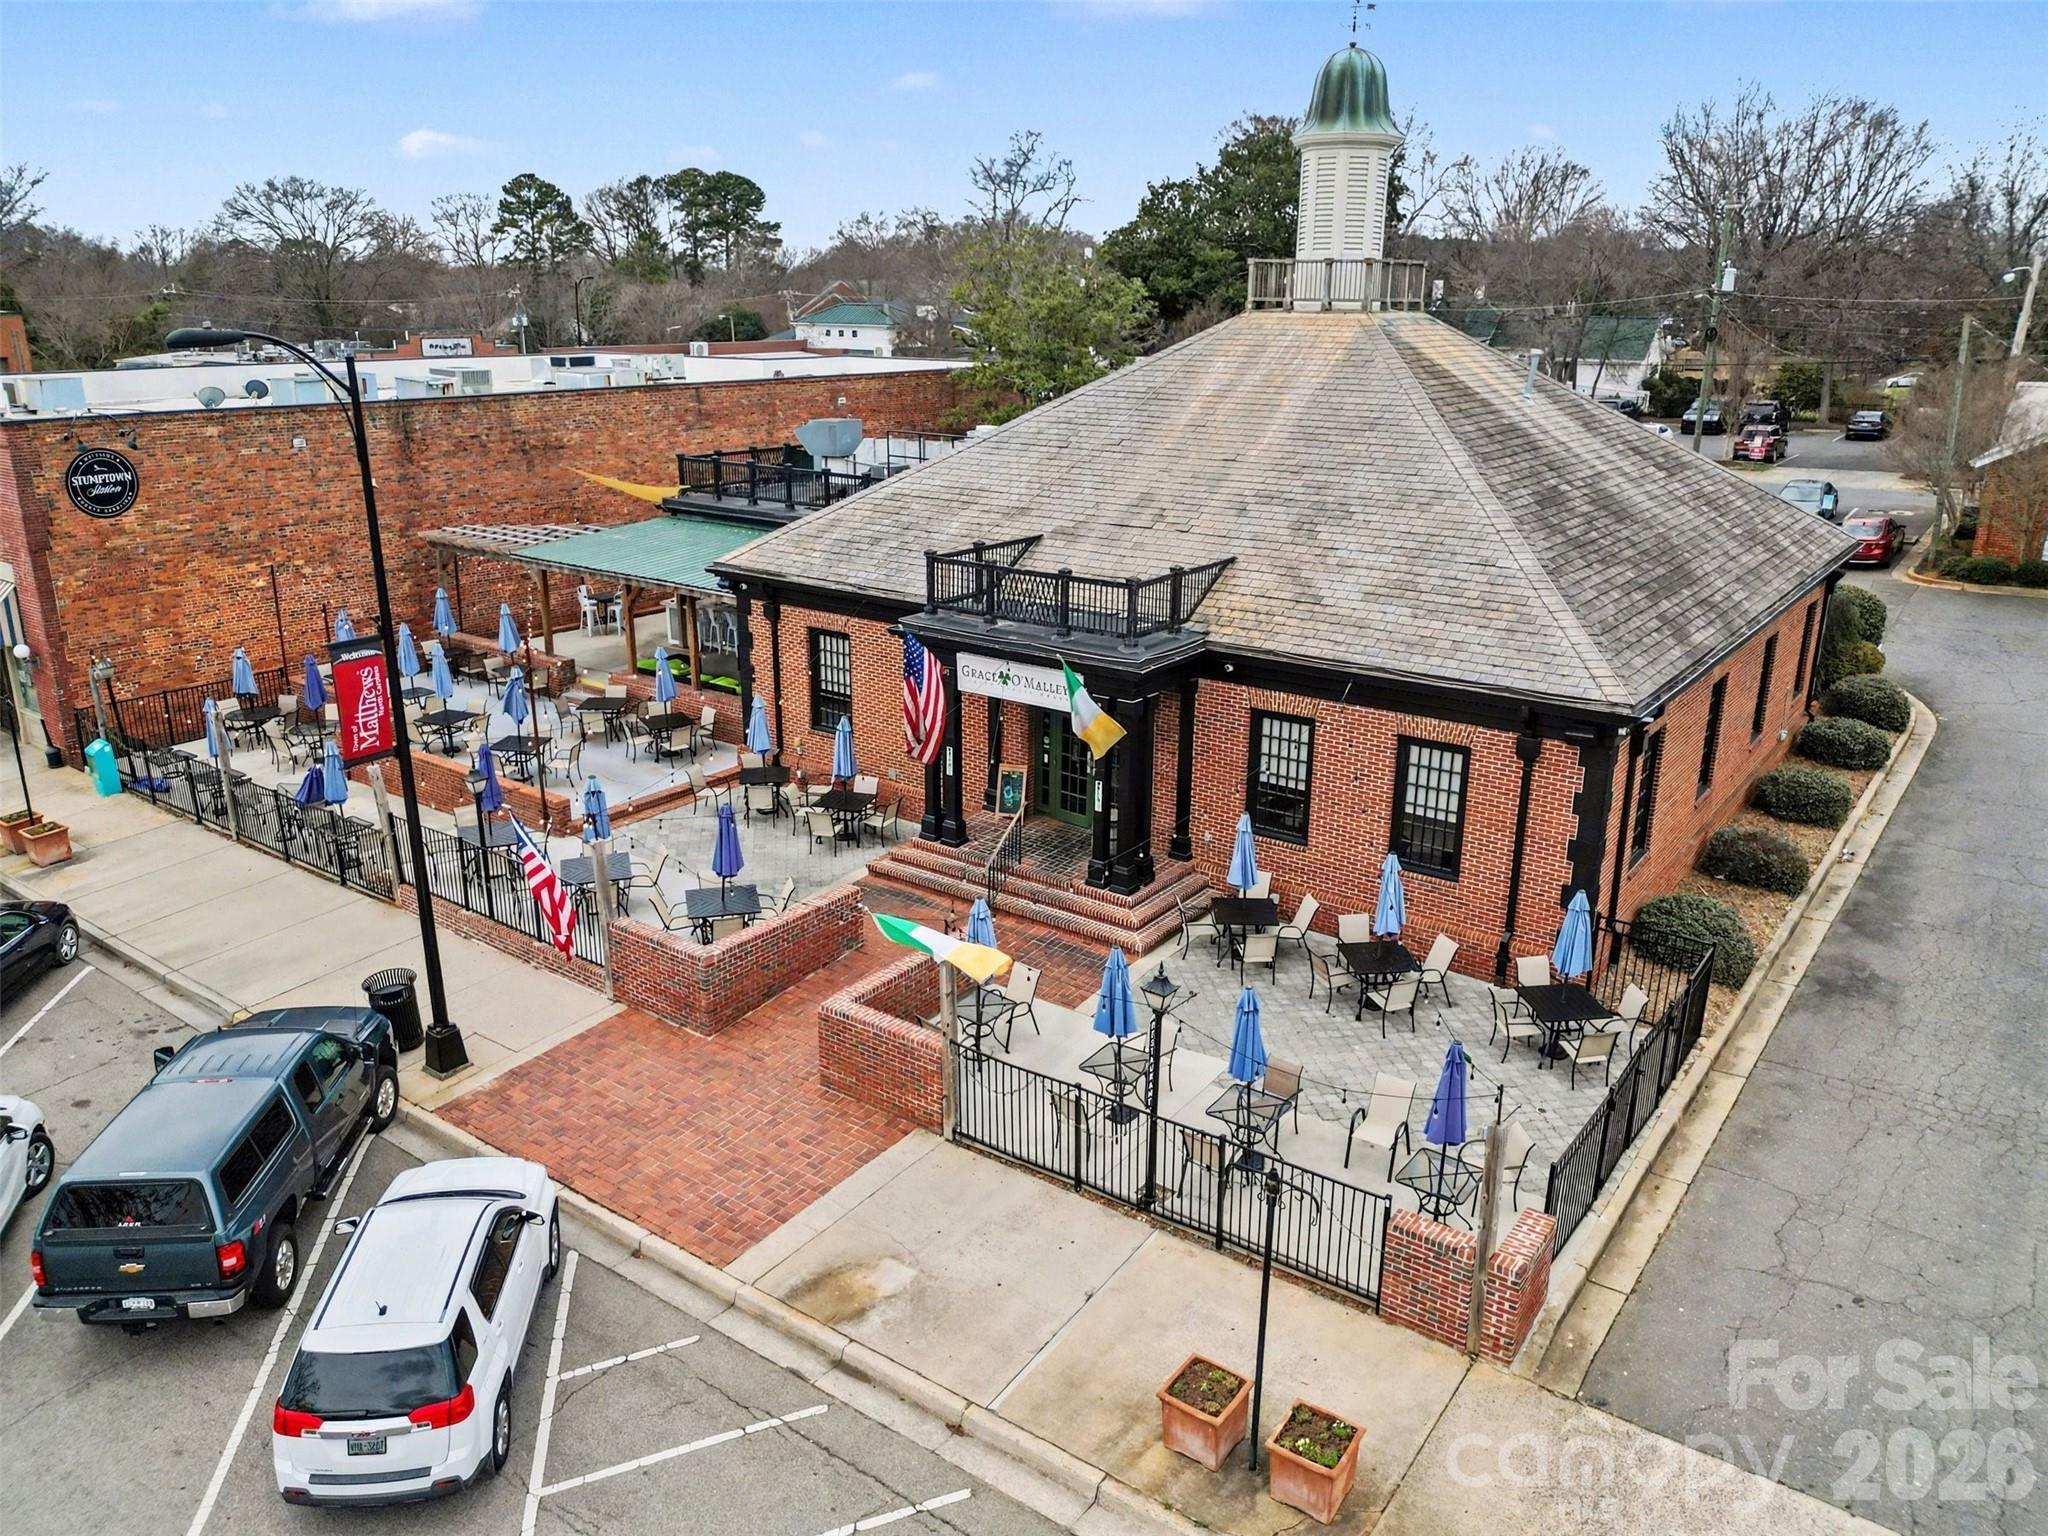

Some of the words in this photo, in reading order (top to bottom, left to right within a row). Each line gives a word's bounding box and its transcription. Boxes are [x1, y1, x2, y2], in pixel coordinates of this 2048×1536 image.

[71, 472, 132, 486] STUMPTOWN
[87, 484, 122, 497] Station
[374, 666, 383, 695] Carolina
[354, 666, 380, 751] Matthews
[351, 725, 358, 733] of
